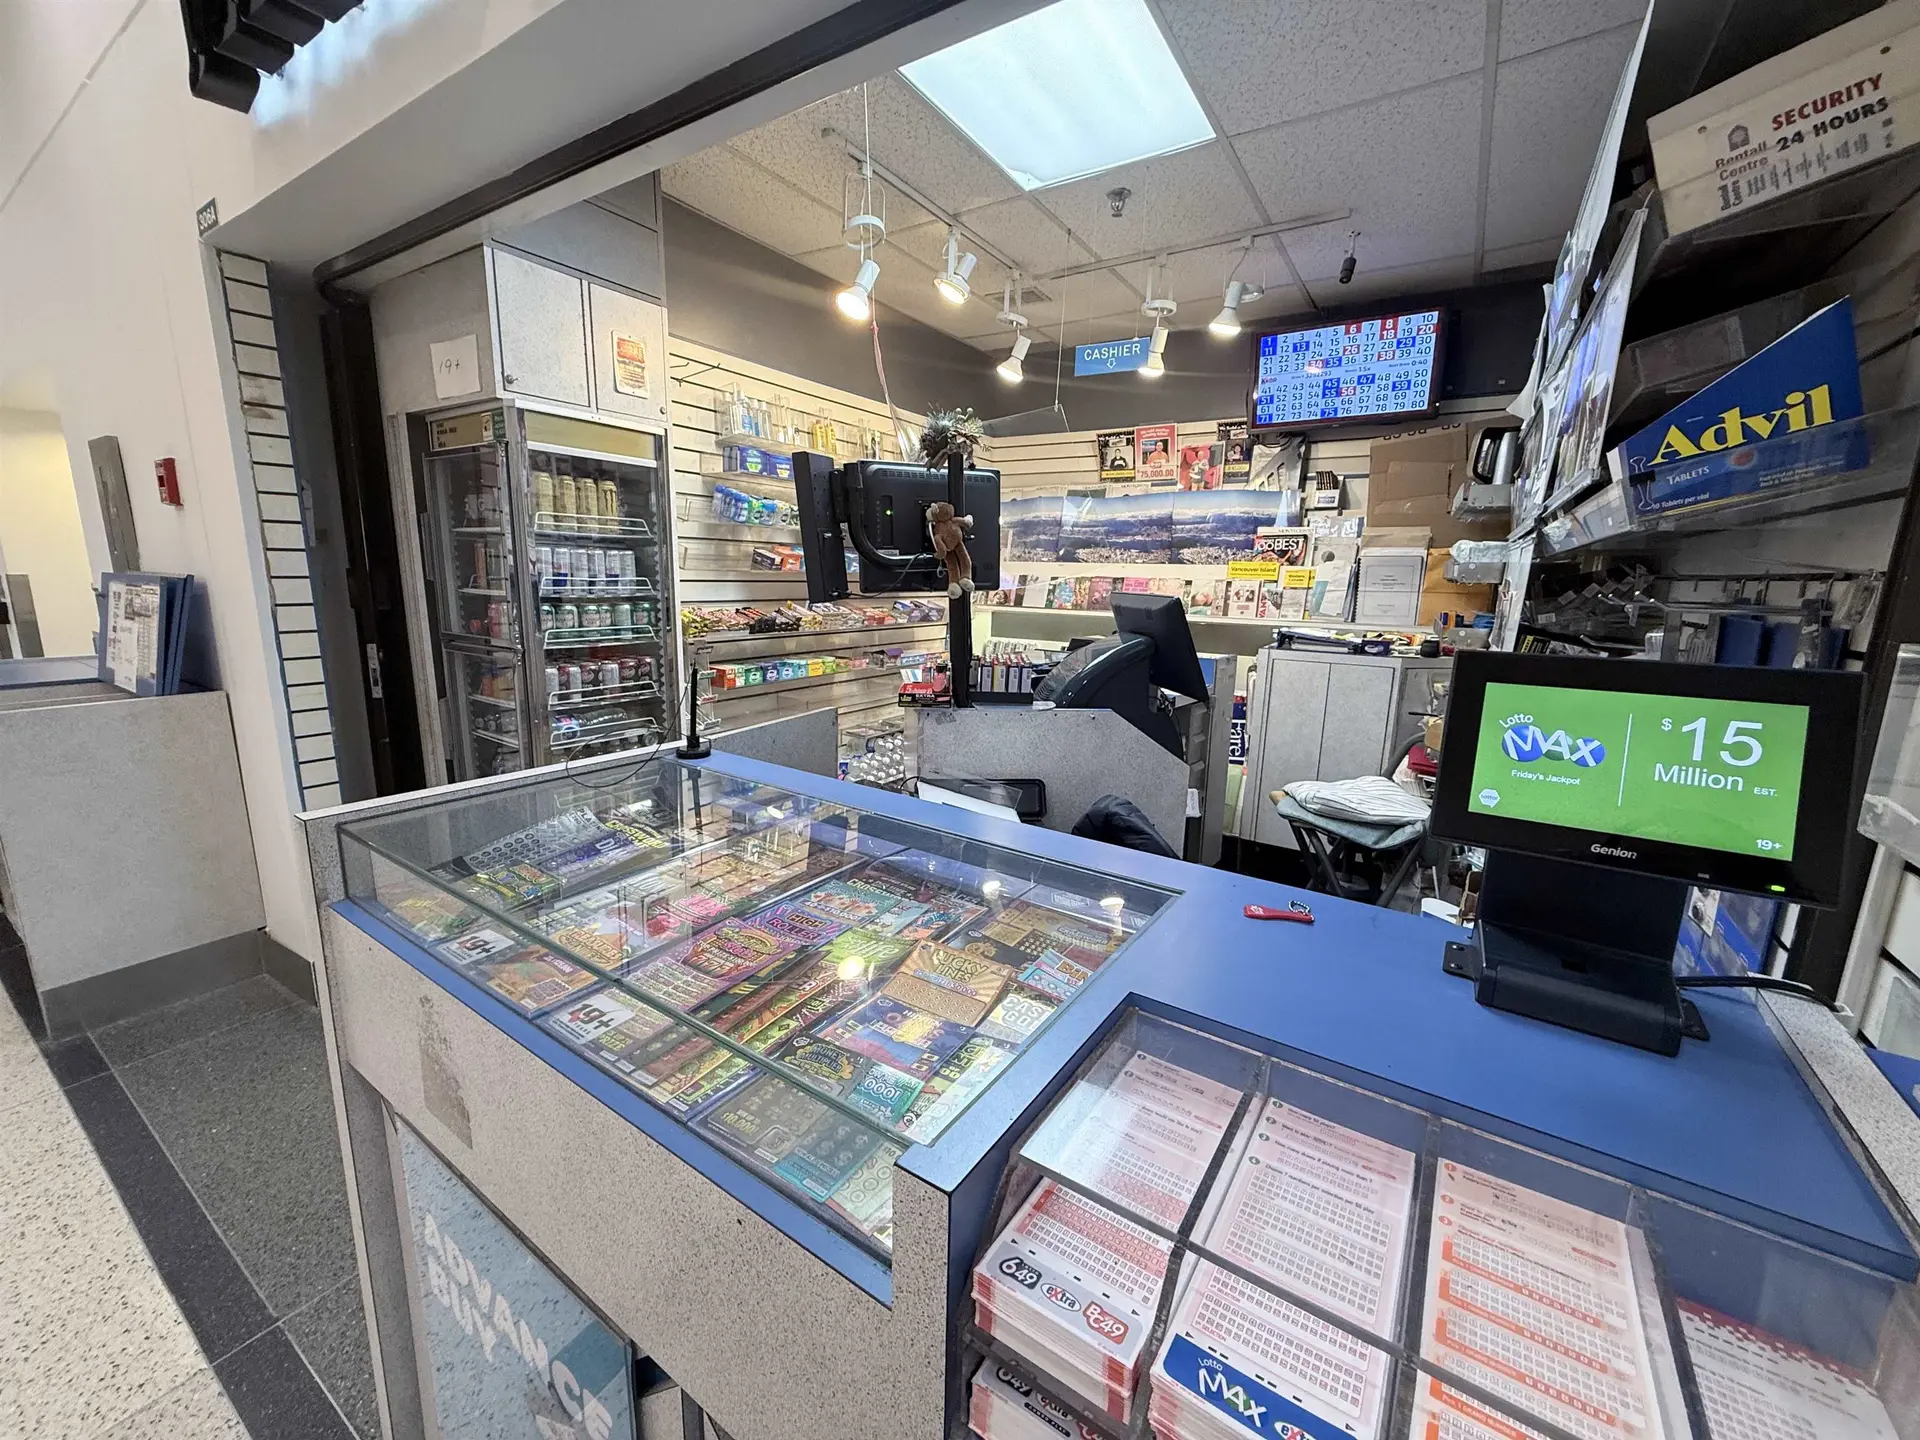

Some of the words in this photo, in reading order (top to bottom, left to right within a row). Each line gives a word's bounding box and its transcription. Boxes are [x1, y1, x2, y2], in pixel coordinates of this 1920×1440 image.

[1772, 73, 1883, 131] SECURITY
[1775, 131, 1805, 153] 24
[1814, 97, 1889, 138] HOURS
[1719, 155, 1769, 181] Centre
[1267, 336, 1272, 345] 1
[1332, 328, 1338, 336] 5
[1350, 324, 1356, 333] 6
[1368, 322, 1374, 330] 7
[1385, 319, 1392, 328] 8
[1405, 317, 1411, 325] 9
[1422, 314, 1433, 322] 10
[1280, 344, 1289, 352] 12
[1296, 342, 1305, 350] 13
[1312, 340, 1322, 348] 14
[1330, 337, 1339, 345] 15
[1347, 335, 1357, 343] 16
[1365, 332, 1375, 341] 17
[1382, 329, 1394, 338] 18
[1402, 327, 1412, 336] 19
[1419, 324, 1433, 334] 20
[1084, 343, 1141, 361] CASHIER
[1263, 366, 1271, 374] 31
[1278, 364, 1288, 372] 32
[1294, 362, 1304, 371] 33
[1327, 357, 1338, 366] 35
[1344, 356, 1356, 364] 36
[1362, 353, 1374, 362] 37
[1379, 350, 1392, 360] 38
[1398, 348, 1410, 357] 39
[1416, 346, 1430, 354] 40
[1278, 354, 1289, 362] 22
[1294, 352, 1305, 360] 23
[1311, 350, 1322, 358] 24
[1328, 348, 1339, 356] 25
[1345, 344, 1358, 355] 26
[1363, 343, 1374, 351] 27
[1380, 340, 1393, 349] 28
[1399, 338, 1412, 347] 29
[1418, 336, 1431, 344] 30
[439, 358, 461, 374] 19+
[1260, 394, 1271, 403] 51
[1276, 394, 1286, 402] 52
[1292, 392, 1302, 400] 53
[1308, 391, 1319, 399] 54
[1324, 388, 1337, 398] 55
[1340, 386, 1354, 397] 56
[1359, 385, 1370, 393] 57
[1376, 383, 1388, 392] 58
[1394, 381, 1407, 390] 59
[1413, 379, 1426, 387] 60
[1276, 384, 1287, 392] 42
[1325, 378, 1337, 387] 45
[1342, 376, 1354, 384] 46
[1360, 375, 1372, 383] 47
[1377, 373, 1390, 381] 48
[1395, 370, 1408, 378] 49
[1414, 368, 1427, 377] 50
[1259, 415, 1270, 424] 71
[1322, 408, 1336, 418] 75
[1340, 406, 1351, 414] 76
[1375, 403, 1386, 411] 78
[1393, 401, 1404, 409] 79
[1411, 399, 1424, 408] 80
[1275, 403, 1286, 411] 62
[1291, 402, 1302, 410] 63
[1307, 400, 1318, 408] 64
[1341, 397, 1352, 405] 66
[1358, 395, 1370, 403] 67
[1376, 393, 1388, 401] 68
[1394, 391, 1406, 400] 69
[1413, 389, 1424, 398] 70
[1647, 384, 1835, 466] Advil
[1666, 465, 1710, 485] TABLETS
[1661, 498, 1684, 508] Tablets
[1260, 565, 1276, 573] Island
[1499, 712, 1534, 728] Lotto
[1502, 725, 1602, 767] MAX
[1661, 717, 1673, 731] $
[1681, 717, 1764, 767] 15
[1511, 769, 1544, 782] Friday's
[1545, 773, 1581, 786] Jackpot
[1653, 762, 1743, 792] Million
[1753, 786, 1778, 797] EST.
[1590, 842, 1637, 860] Genion
[1755, 837, 1782, 851] 19+
[769, 917, 820, 941] ROLLER
[787, 913, 826, 928] HIGH
[457, 936, 496, 955] 19+
[937, 964, 972, 983] LINES
[567, 1003, 617, 1031] 19+
[801, 1052, 842, 1073] MULTIPLIER
[812, 1043, 843, 1061] MONEY
[1001, 1258, 1039, 1286] 649
[1086, 1304, 1126, 1337] BC49
[1199, 1357, 1223, 1371] Lotto
[1199, 1370, 1266, 1428] MAX
